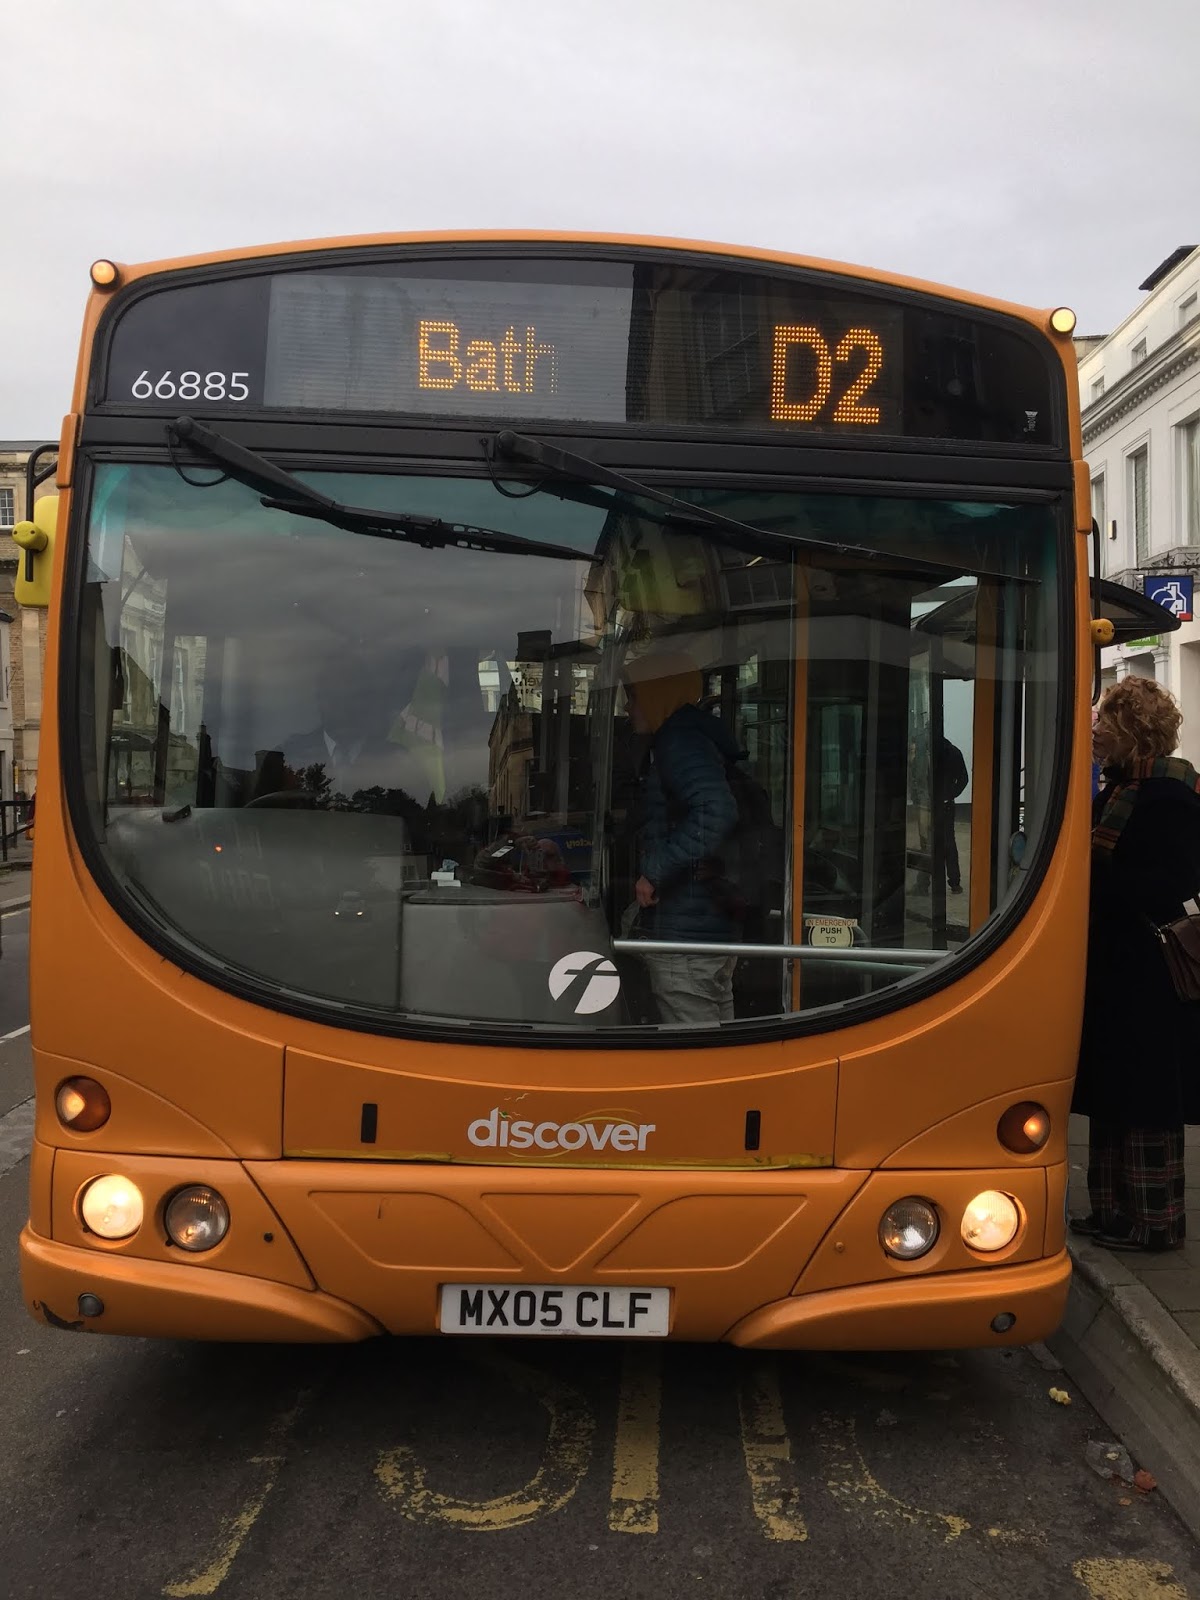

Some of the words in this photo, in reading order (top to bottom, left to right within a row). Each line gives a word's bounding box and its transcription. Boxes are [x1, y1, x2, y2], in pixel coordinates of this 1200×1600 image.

[419, 320, 559, 394] Bath
[771, 325, 883, 423] D2
[131, 370, 249, 401] 66885
[825, 936, 837, 944] TO
[467, 1107, 656, 1151] discover
[459, 1289, 563, 1327] MX05
[576, 1291, 652, 1328] CLF
